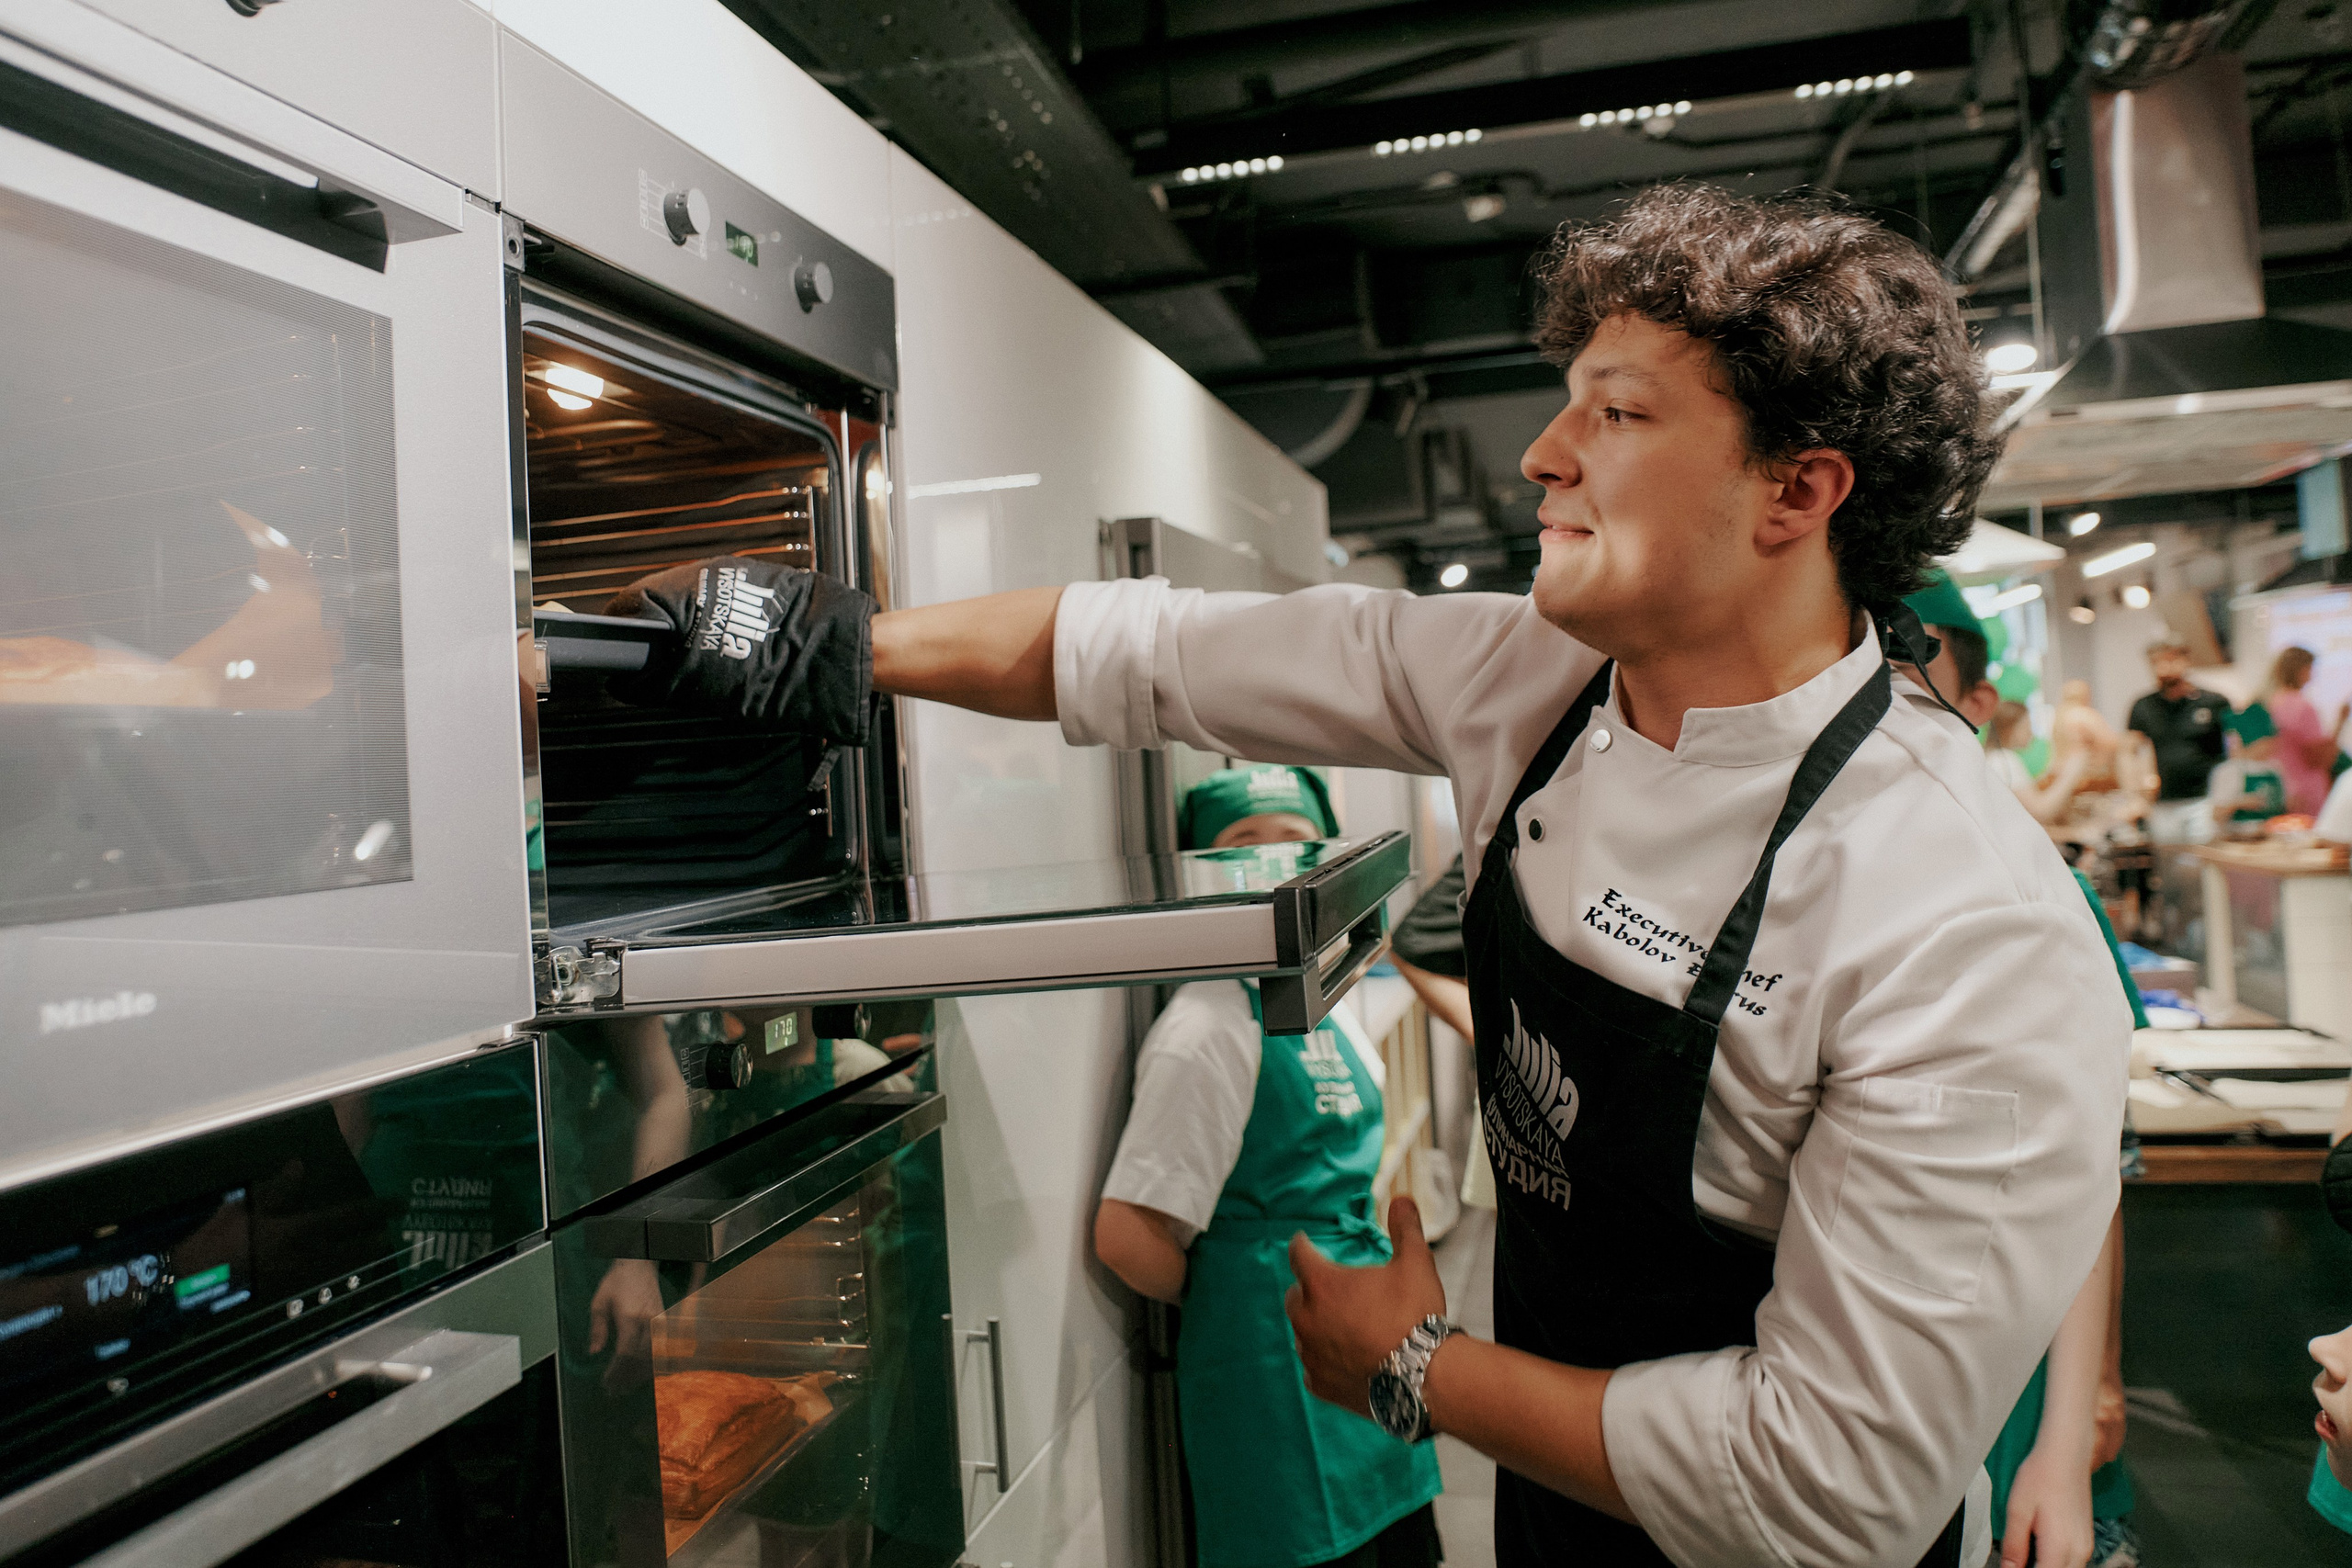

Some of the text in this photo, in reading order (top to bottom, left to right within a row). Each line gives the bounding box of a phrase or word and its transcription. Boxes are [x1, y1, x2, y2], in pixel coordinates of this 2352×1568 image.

[699, 567, 735, 650] VYSOTSKAYA
[720, 568, 775, 660] Julia
[1582, 906, 1677, 963] Kabolov
[1601, 887, 1710, 961] Executive
[39, 991, 158, 1033] Miele
[775, 1018, 793, 1039] 170
[1495, 1052, 1566, 1170] VYSOTSKAYA
[1502, 998, 1579, 1142] Julia
[1484, 1114, 1572, 1212] СТУДИЯ
[1486, 1092, 1570, 1179] КУЛИНАРНАЯ
